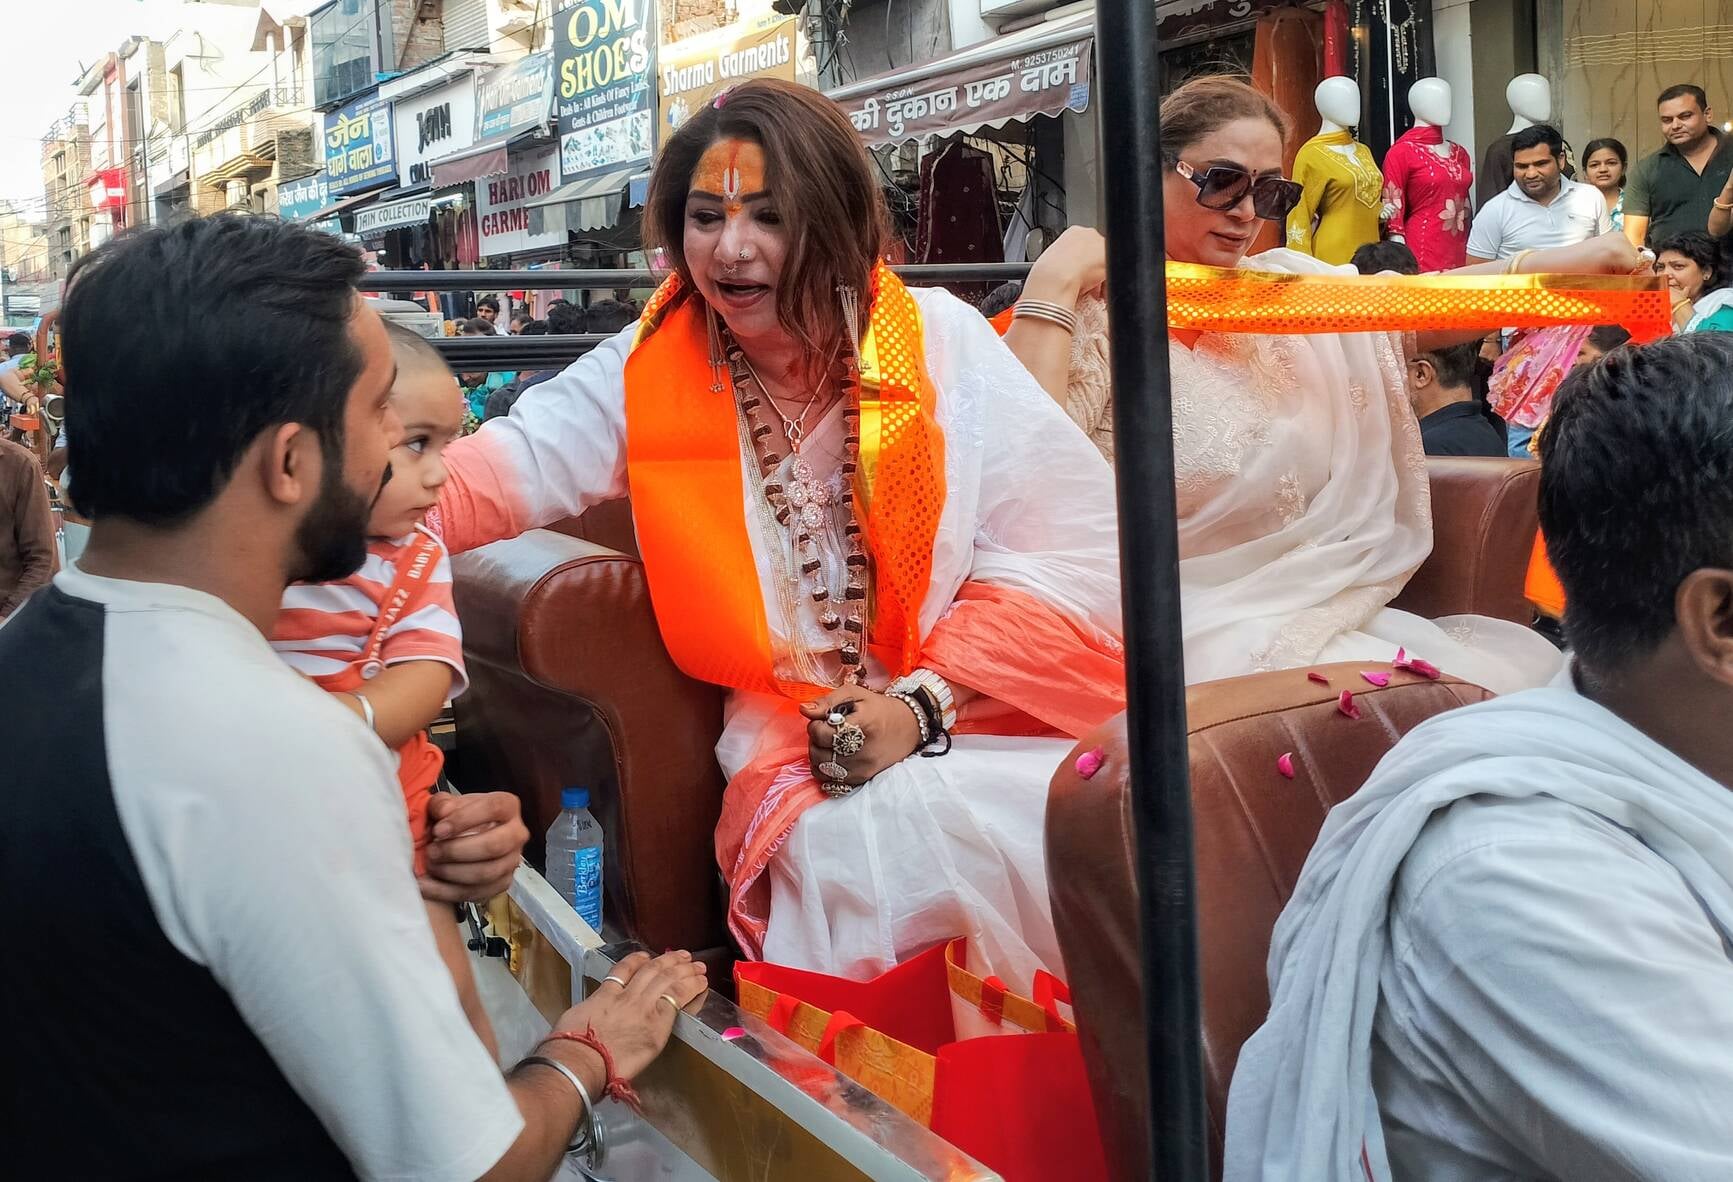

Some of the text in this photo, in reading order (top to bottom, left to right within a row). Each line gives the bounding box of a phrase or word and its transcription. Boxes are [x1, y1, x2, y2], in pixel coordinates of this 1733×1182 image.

[568, 0, 639, 48] OM
[560, 30, 648, 98] SHOES
[663, 31, 789, 96] Sharma Garments
[1024, 44, 1081, 69] 9253750241
[885, 86, 958, 137] दुकान
[963, 73, 1016, 108] एक
[1020, 57, 1079, 92] दाम
[326, 112, 370, 148] जैन
[416, 102, 451, 154] JAIN
[488, 169, 551, 205] HARI OM
[358, 202, 428, 230] JAIN COLLECTION
